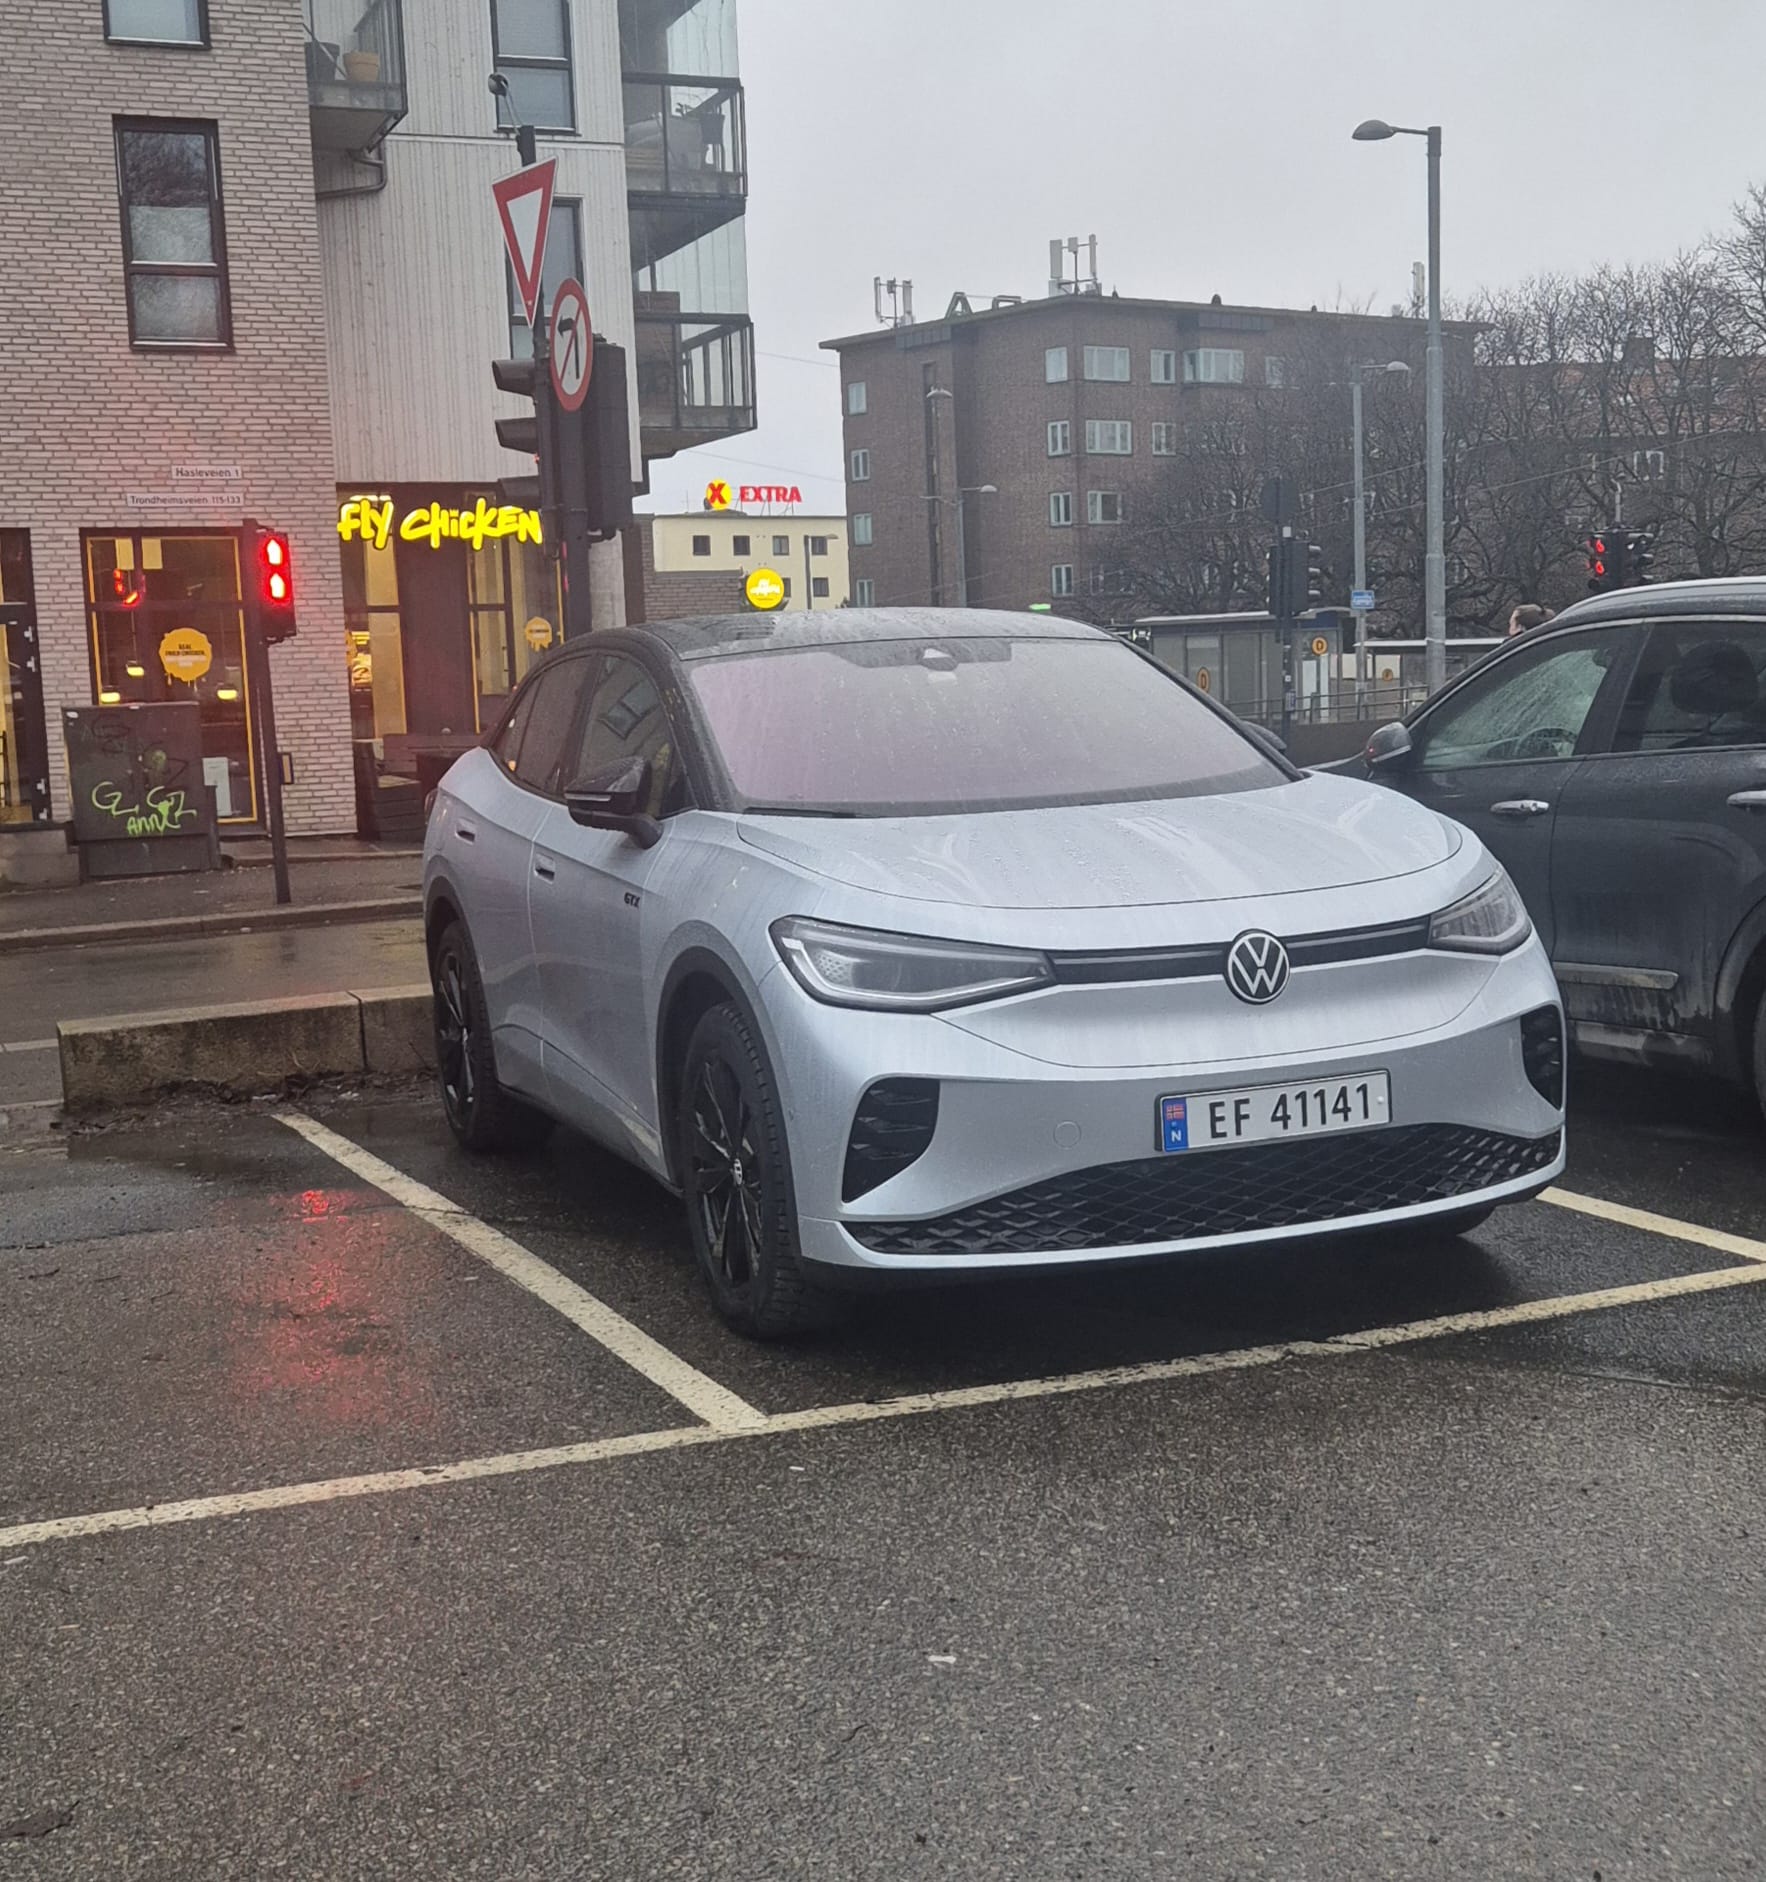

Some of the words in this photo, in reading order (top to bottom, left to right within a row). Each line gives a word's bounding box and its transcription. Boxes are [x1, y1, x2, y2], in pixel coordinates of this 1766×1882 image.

[175, 467, 232, 477] Hasleveien
[130, 495, 208, 505] Trondheimsveien
[739, 486, 802, 503] EXTRA
[624, 892, 641, 909] GTX
[1208, 1098, 1251, 1139] EF
[1270, 1083, 1369, 1130] 41141
[1170, 1129, 1182, 1143] N
